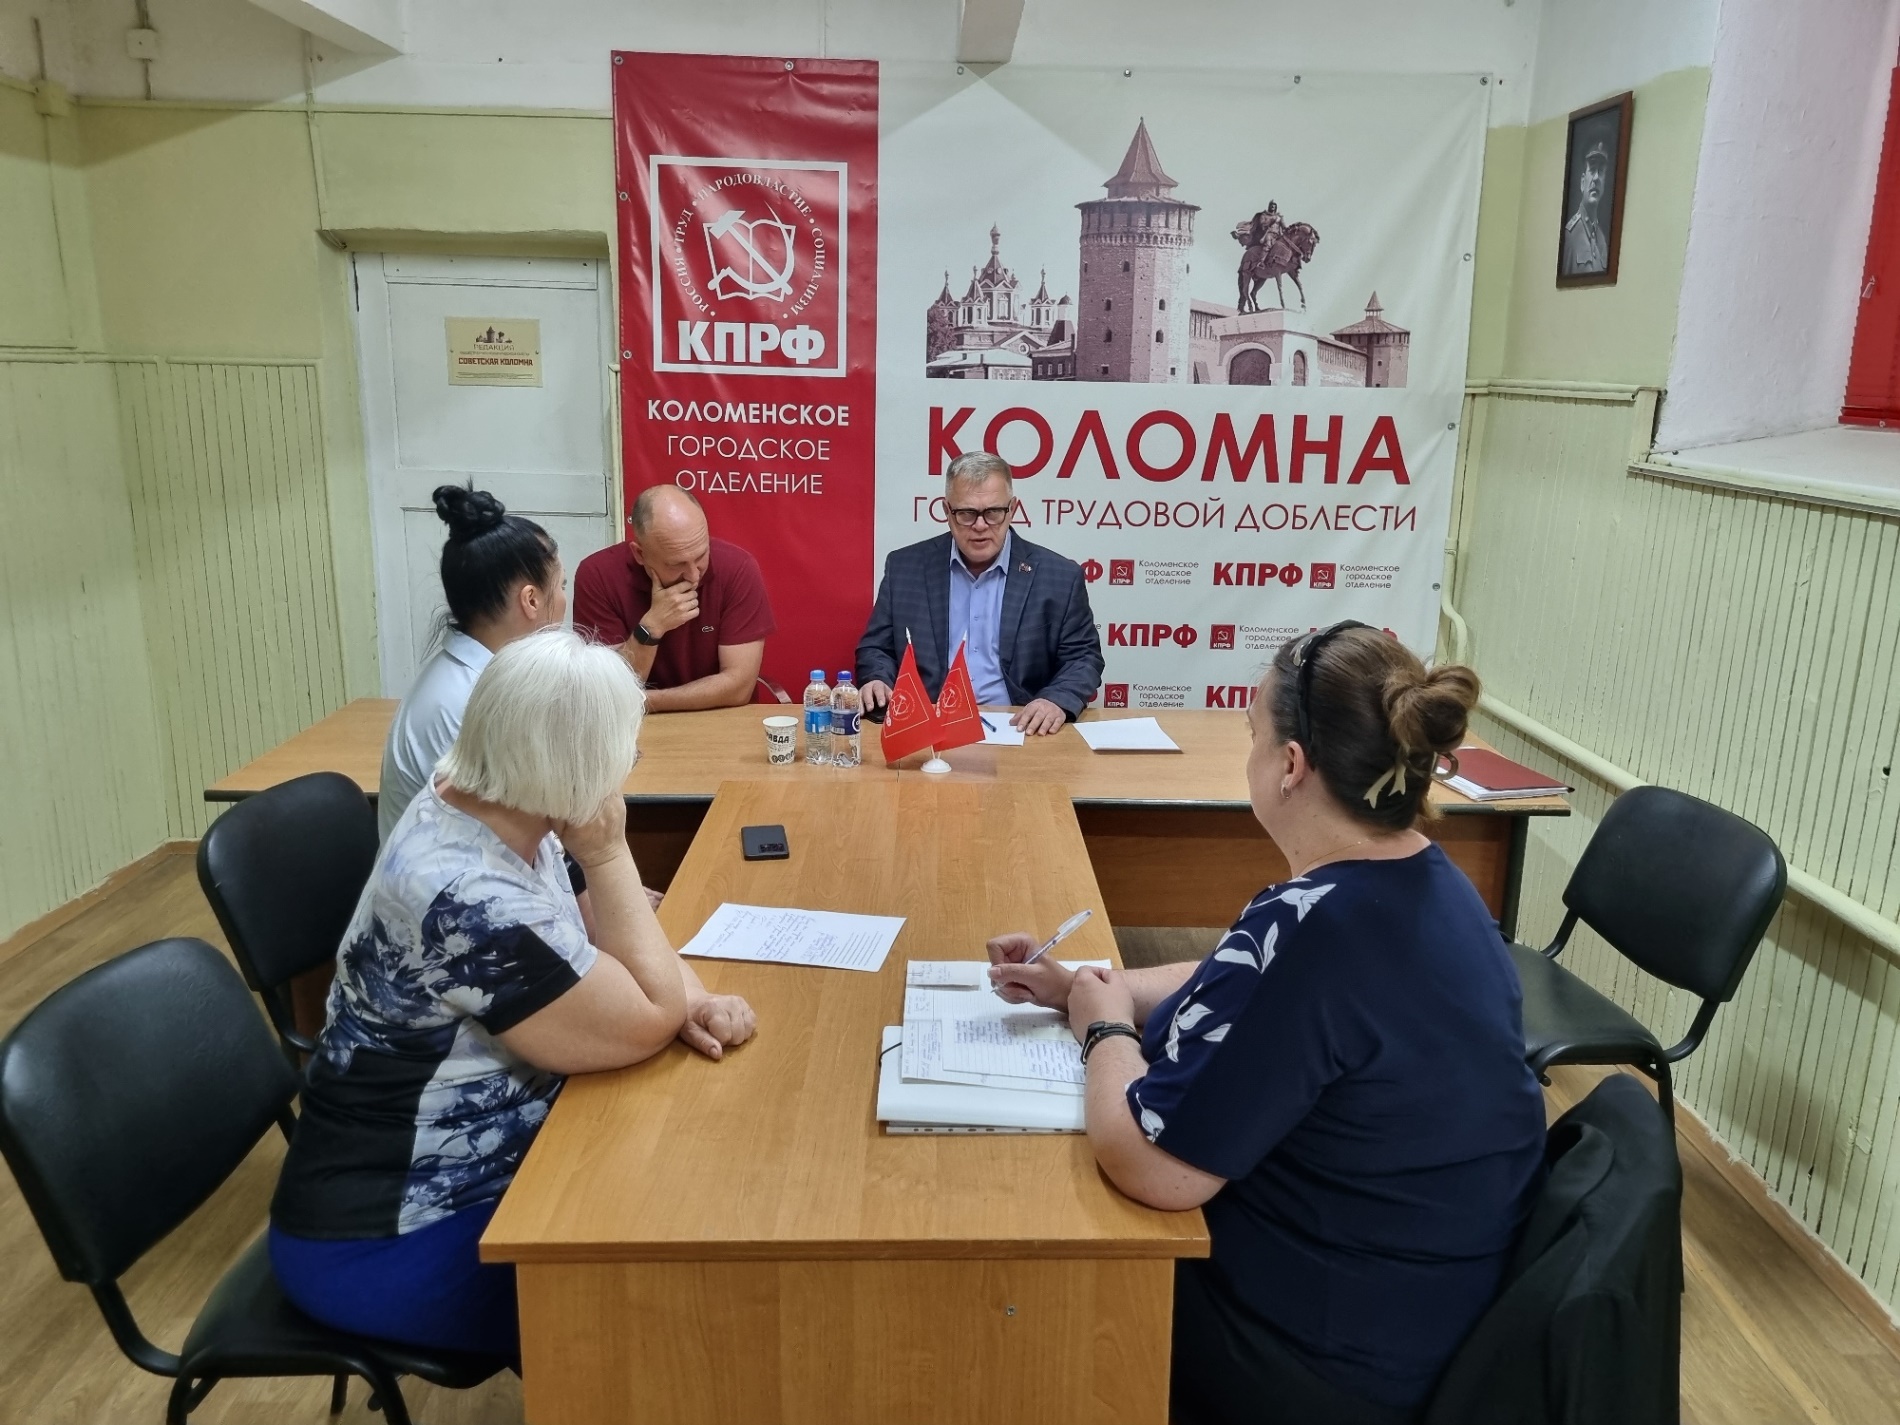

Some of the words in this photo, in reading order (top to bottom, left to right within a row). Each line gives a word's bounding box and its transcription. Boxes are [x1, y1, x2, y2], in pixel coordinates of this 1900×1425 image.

[697, 173, 812, 218] НАРОДОВЛАСТИЕ
[674, 208, 694, 243] ТРУД
[790, 227, 825, 316] СОЦИАЛИЗМ
[673, 255, 708, 313] РОССИЯ
[678, 320, 825, 364] КПРФ
[458, 357, 499, 365] СОВЕТСКАЯ
[500, 358, 533, 366] КОЛОМНА
[648, 399, 849, 426] КОЛОМЕНСКОЕ
[668, 435, 830, 461] ГОРОДСКОЕ
[928, 406, 1410, 485] КОЛОМНА
[675, 469, 823, 494] ОТДЕЛЕНИЕ
[914, 496, 1031, 528] ГОД
[1041, 496, 1224, 529] ТРУДОВОЙ
[1234, 503, 1416, 532] ДОБЛЕСТИ
[1138, 560, 1199, 569] Коломенское
[1145, 569, 1192, 577] городское
[1212, 562, 1303, 587] КПРФ
[1340, 564, 1400, 572] Коломенское
[1145, 577, 1191, 585] отделение
[1345, 573, 1392, 581] городское
[1345, 581, 1391, 589] отделение
[1107, 623, 1198, 648] КПРФ
[1239, 625, 1299, 634] Коломенское
[1133, 684, 1192, 692] Коломенское
[1139, 692, 1185, 700] городское
[1206, 685, 1258, 709] КП
[1138, 700, 1184, 708] отделение
